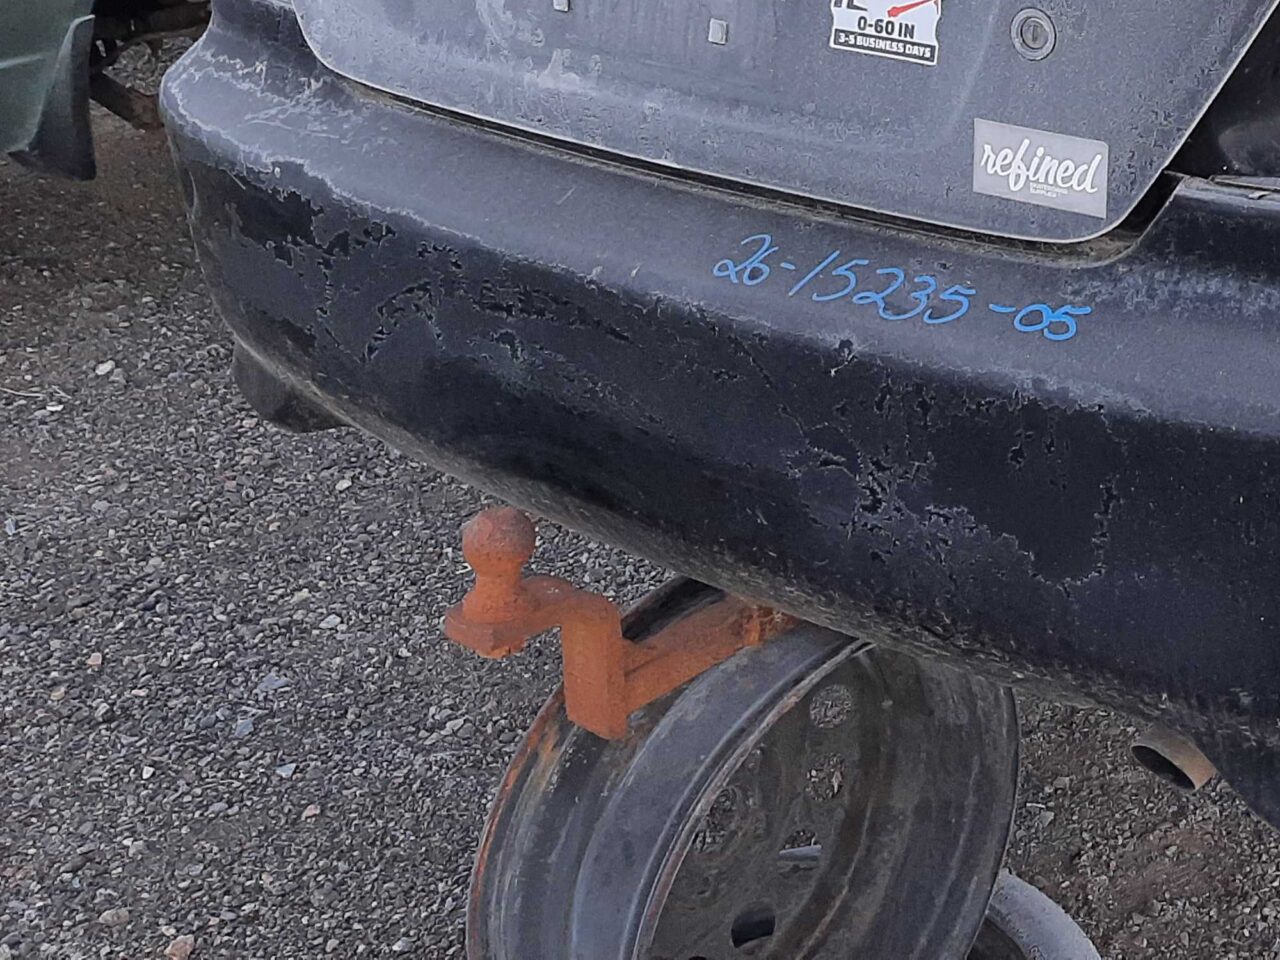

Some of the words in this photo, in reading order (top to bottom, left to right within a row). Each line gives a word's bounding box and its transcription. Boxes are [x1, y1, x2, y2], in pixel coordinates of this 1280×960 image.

[857, 15, 895, 36] 0-60
[898, 22, 916, 39] IN
[838, 32, 855, 45] 3-5
[856, 35, 904, 53] BUSINESS
[905, 44, 932, 58] DAYS
[980, 138, 1102, 193] refined
